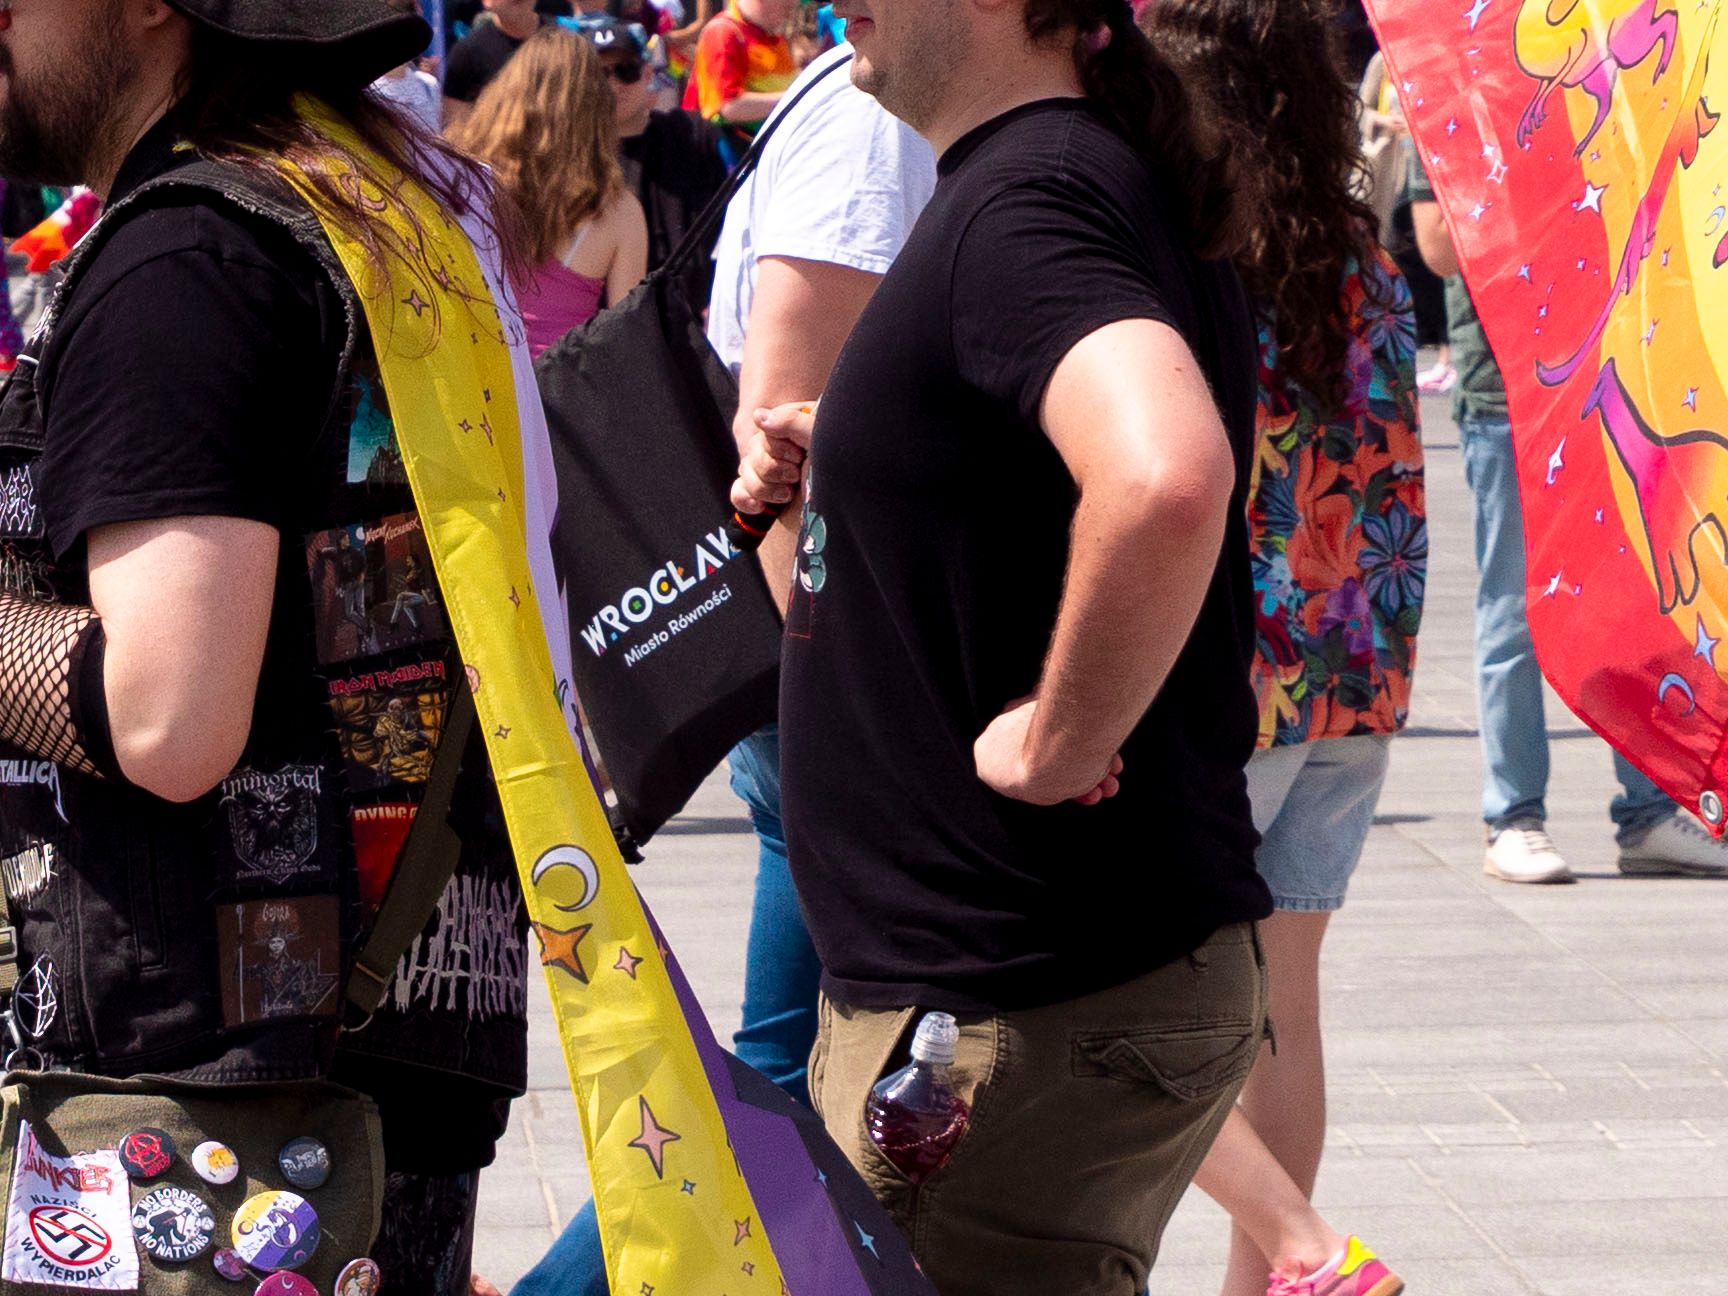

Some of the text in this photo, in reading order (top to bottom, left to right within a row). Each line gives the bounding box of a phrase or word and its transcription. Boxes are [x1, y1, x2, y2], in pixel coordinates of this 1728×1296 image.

[624, 584, 732, 667] Miasto Równości
[329, 660, 445, 695] IRON MAIDEN
[139, 1187, 210, 1213] NO BORDERS
[139, 1233, 210, 1260] NO NATIONS
